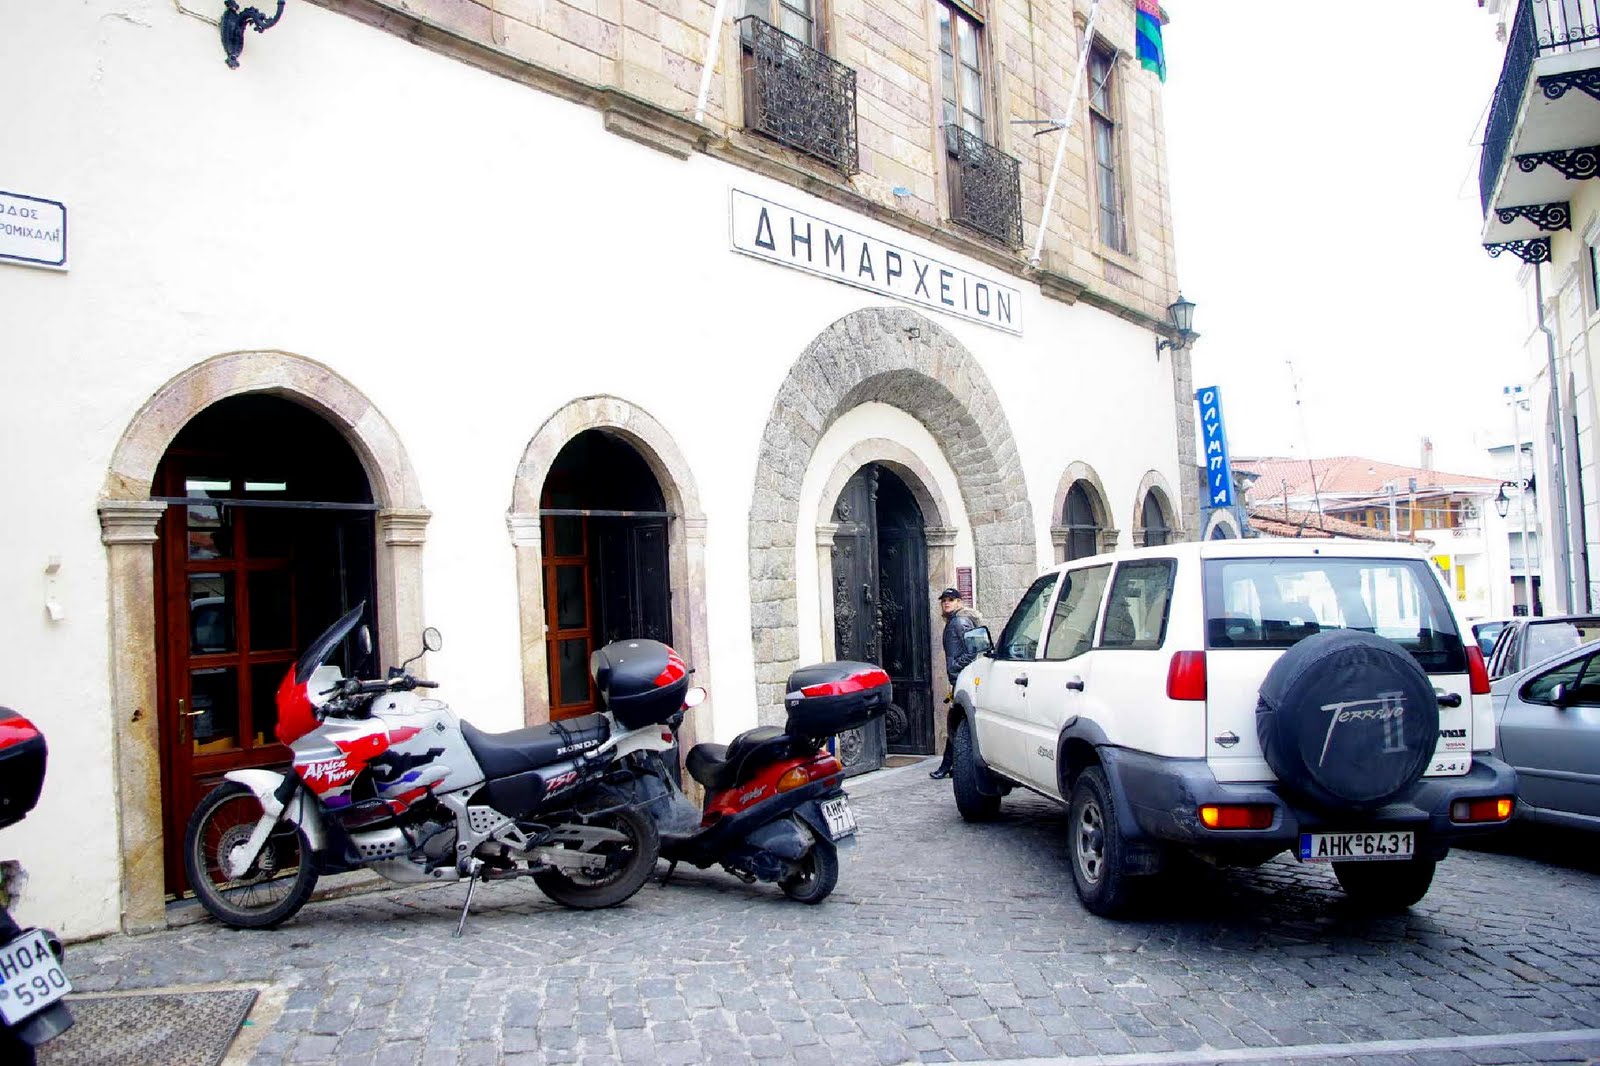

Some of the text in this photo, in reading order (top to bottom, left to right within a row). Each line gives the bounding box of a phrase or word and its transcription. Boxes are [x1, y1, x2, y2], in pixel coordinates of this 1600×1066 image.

[754, 206, 1011, 324] ΔΗΜΑΡΧΕΙΟΝ
[1202, 391, 1227, 504] ΟΛΥΜΠΙΑ
[556, 739, 601, 756] HONDA
[303, 759, 348, 781] Africa
[324, 768, 356, 784] Twin
[0, 939, 50, 980] HOA
[14, 968, 66, 1006] 590
